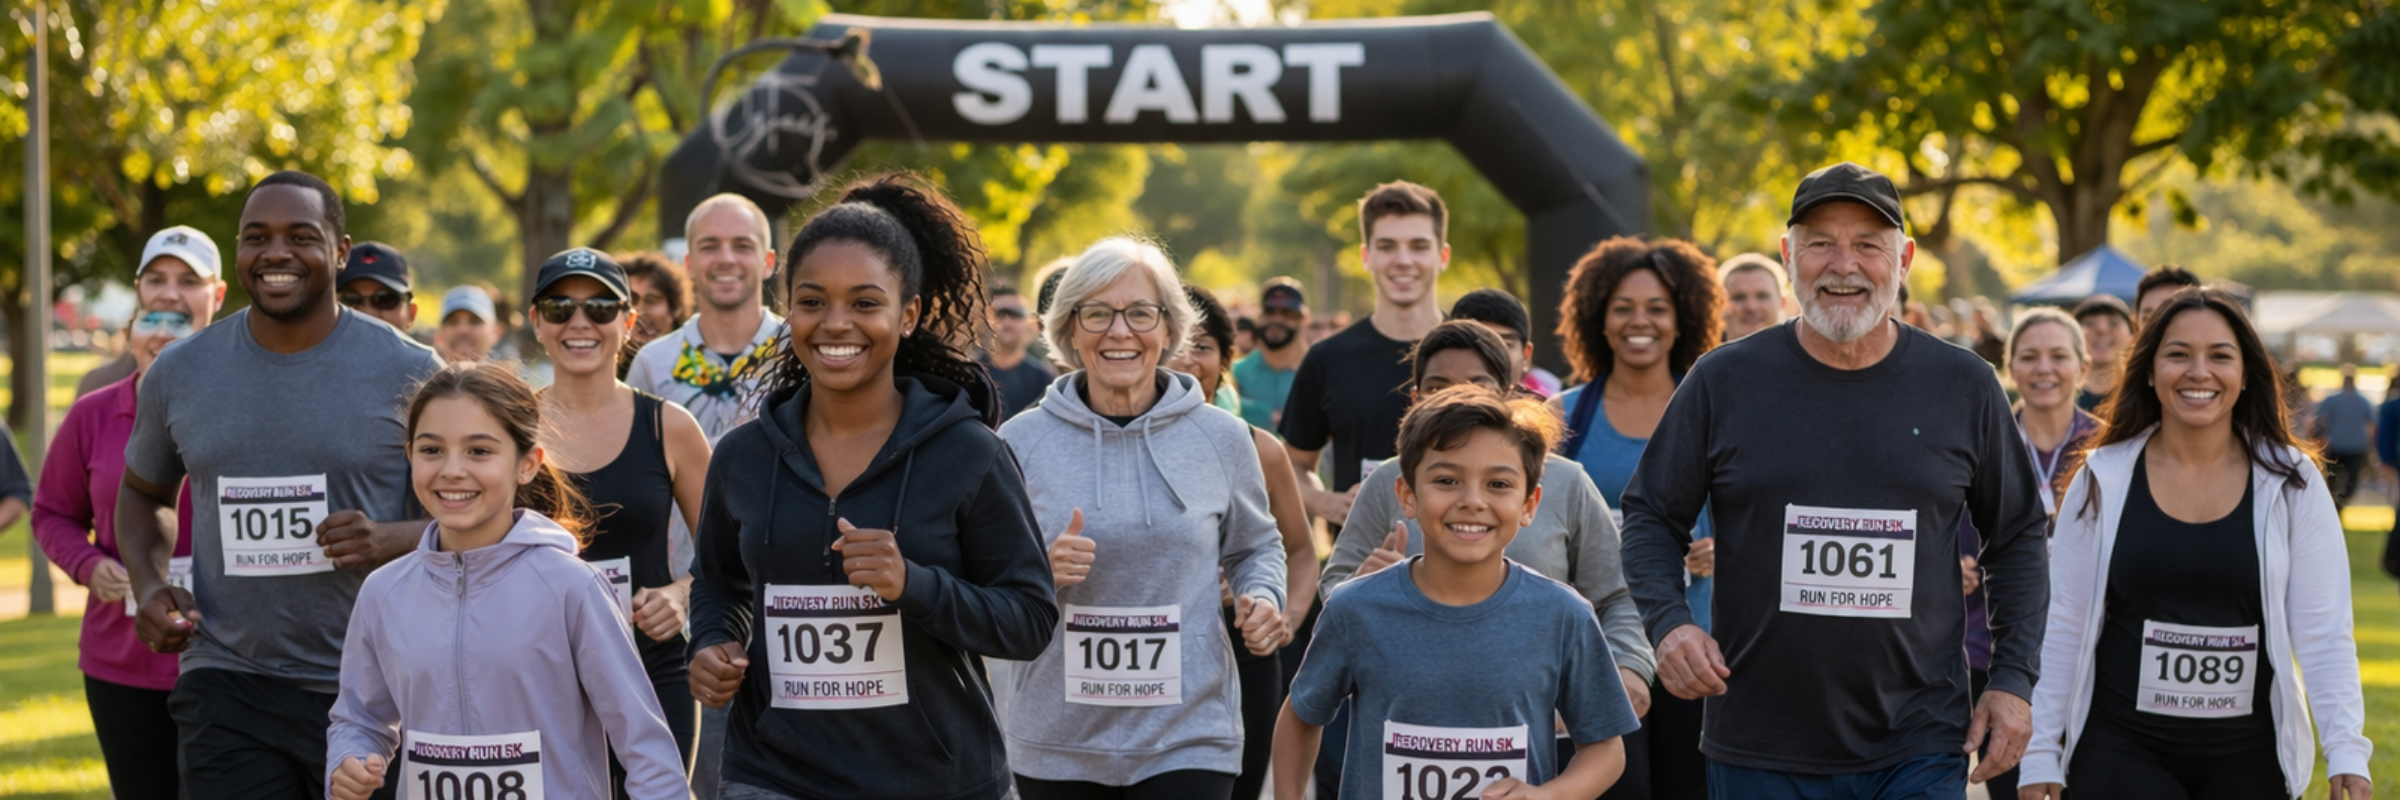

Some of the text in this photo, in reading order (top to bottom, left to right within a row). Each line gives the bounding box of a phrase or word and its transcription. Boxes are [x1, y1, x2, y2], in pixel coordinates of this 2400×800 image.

[951, 41, 1365, 125] START
[231, 507, 313, 540] 1015
[236, 552, 313, 565] RUN FOR HOPE
[1801, 540, 1896, 579] 1061
[1800, 589, 1894, 606] RUN FOR HOPE
[778, 621, 883, 664] 1037
[1079, 637, 1167, 671] 1017
[2156, 651, 2244, 685] 1089
[784, 680, 884, 696] RUN FOR HOPE
[1081, 681, 1165, 696] RUN FOR HOPE
[2154, 693, 2237, 709] RUN FOR HOPE
[1393, 732, 1462, 752] RECOVERY
[1465, 738, 1493, 752] RUN
[418, 770, 527, 800] 1008
